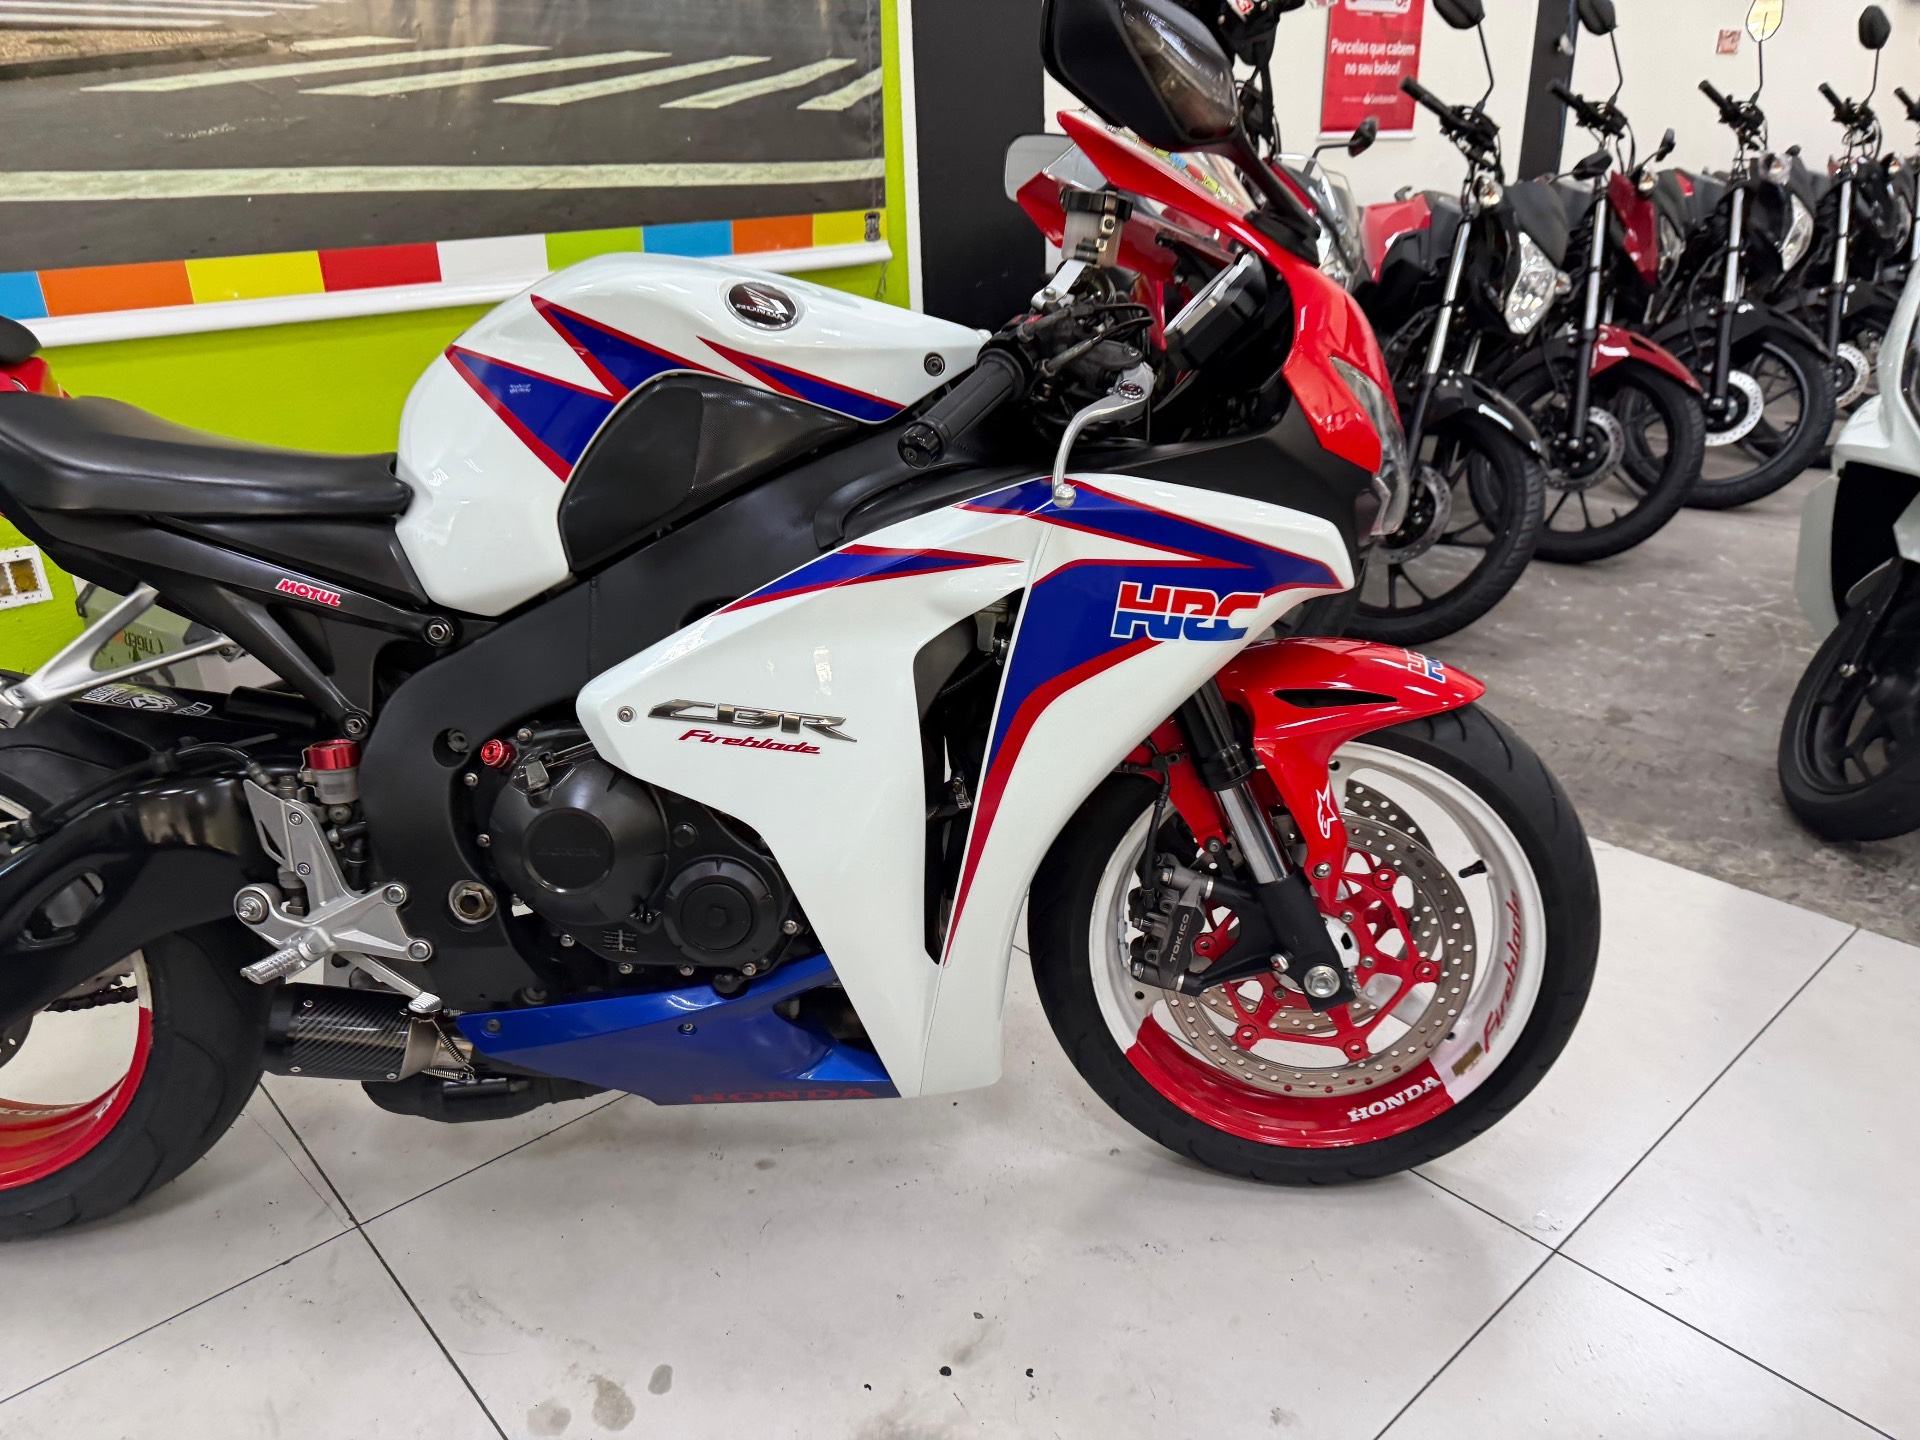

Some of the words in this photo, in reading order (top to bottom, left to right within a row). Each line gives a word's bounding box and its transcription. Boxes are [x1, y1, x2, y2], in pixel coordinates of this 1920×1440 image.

[1331, 38, 1369, 54] Parcelas
[1369, 43, 1386, 59] que
[1386, 41, 1416, 55] cabem
[1344, 62, 1357, 75] no
[1358, 63, 1373, 75] seu
[1373, 59, 1401, 75] bolso!
[275, 578, 341, 607] MOTUL
[1110, 580, 1265, 642] HRC
[648, 698, 857, 742] CBR
[679, 729, 821, 754] Fireblade
[1169, 913, 1190, 962] TOKICO
[691, 1088, 877, 1103] HONDA
[1347, 1076, 1442, 1122] HONDA
